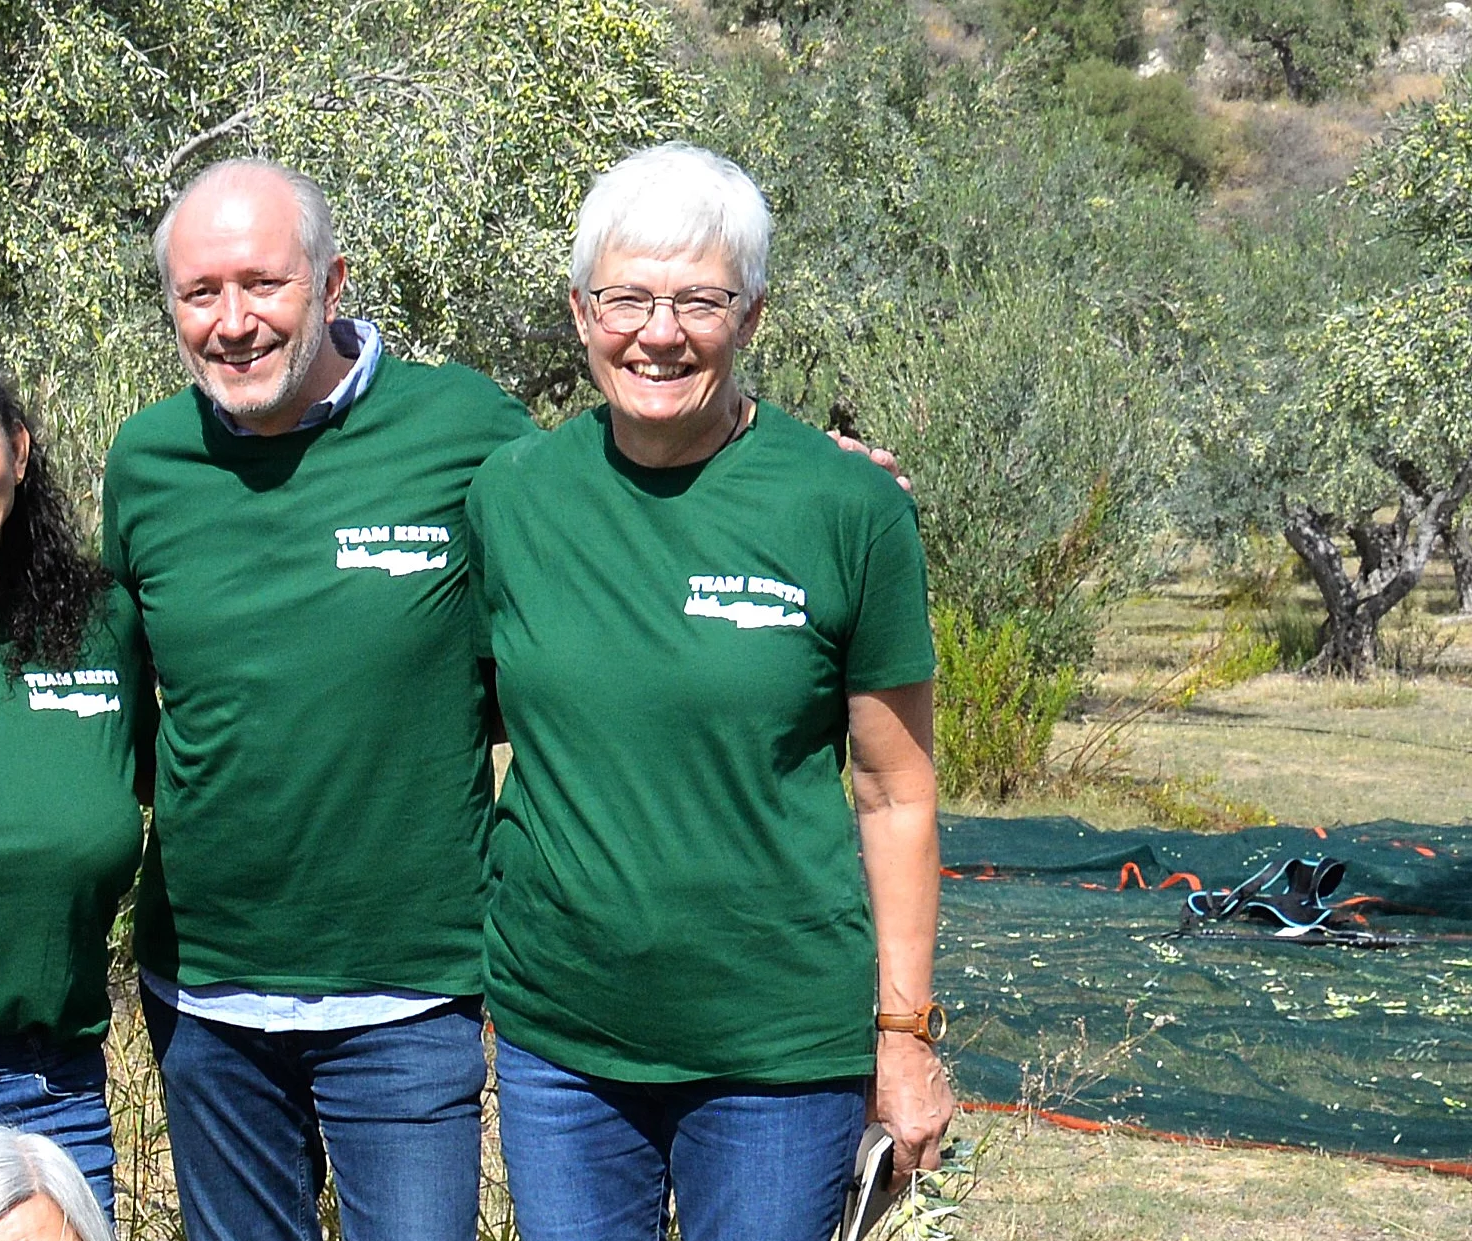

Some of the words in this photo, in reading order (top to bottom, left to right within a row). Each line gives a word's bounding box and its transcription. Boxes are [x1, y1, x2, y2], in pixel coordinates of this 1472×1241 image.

[334, 526, 390, 544] TEAM
[393, 525, 450, 542] KRETA
[688, 575, 744, 592] TEAM
[747, 575, 805, 606] KRETA
[23, 672, 73, 688] TEAM
